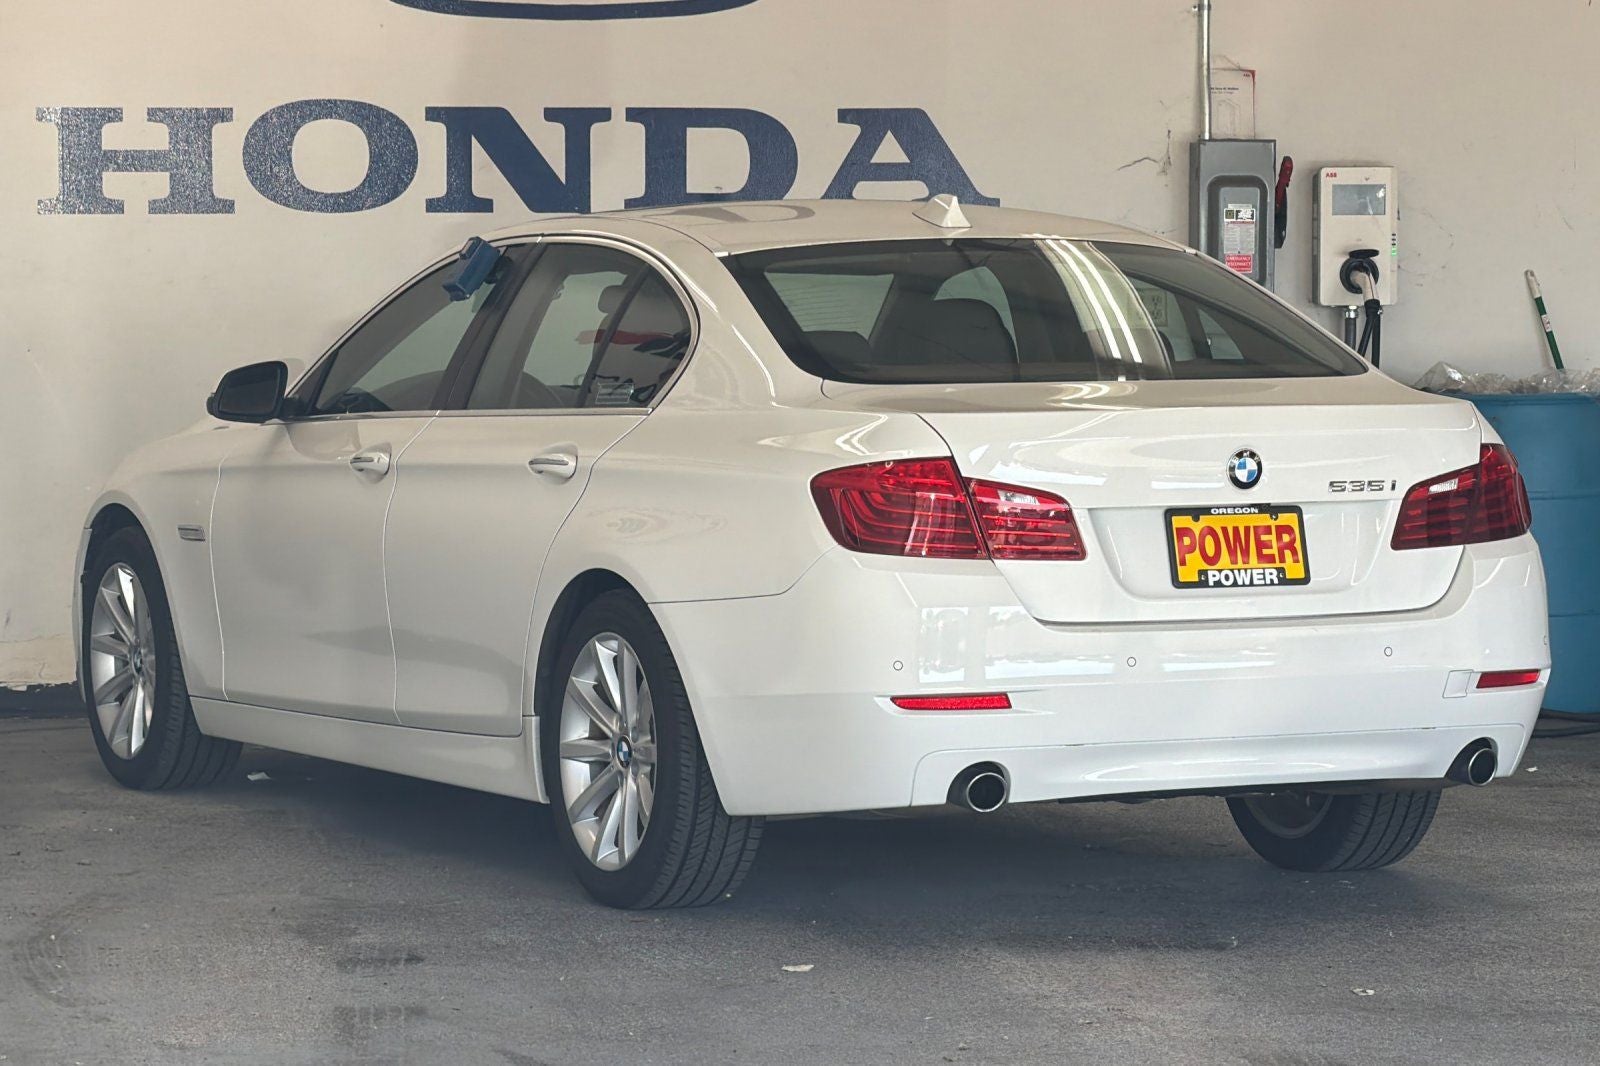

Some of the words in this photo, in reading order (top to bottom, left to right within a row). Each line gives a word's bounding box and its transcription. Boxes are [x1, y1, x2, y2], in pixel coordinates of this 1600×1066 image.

[36, 98, 1000, 214] HONDA
[1328, 480, 1397, 492] 535i
[1210, 507, 1259, 515] OREGON
[1175, 525, 1300, 567] POWER
[1207, 568, 1279, 586] POWER
